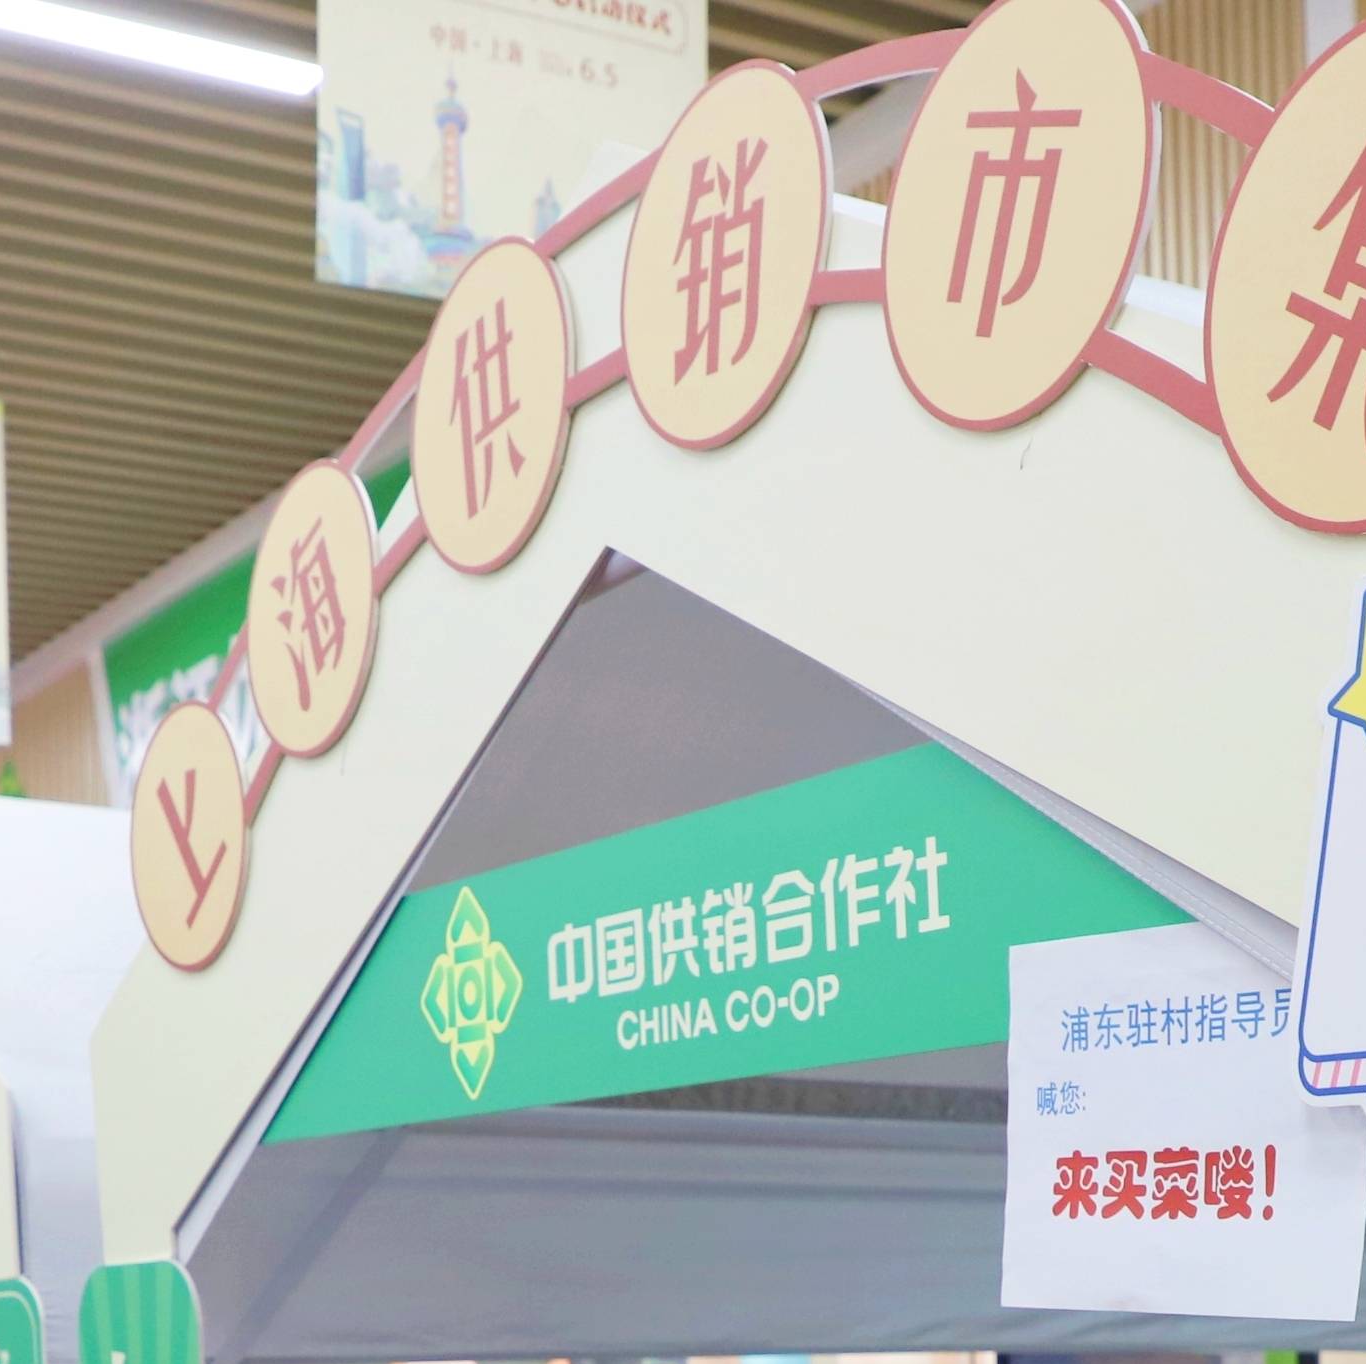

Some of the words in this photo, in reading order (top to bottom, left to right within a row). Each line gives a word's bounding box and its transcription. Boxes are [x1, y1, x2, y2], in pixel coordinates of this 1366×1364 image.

[546, 836, 950, 1003] 中国供销合作社
[616, 1000, 718, 1051] CHINA
[724, 973, 840, 1033] CO-OP
[1060, 986, 1291, 1053] 浦东驻村指导员
